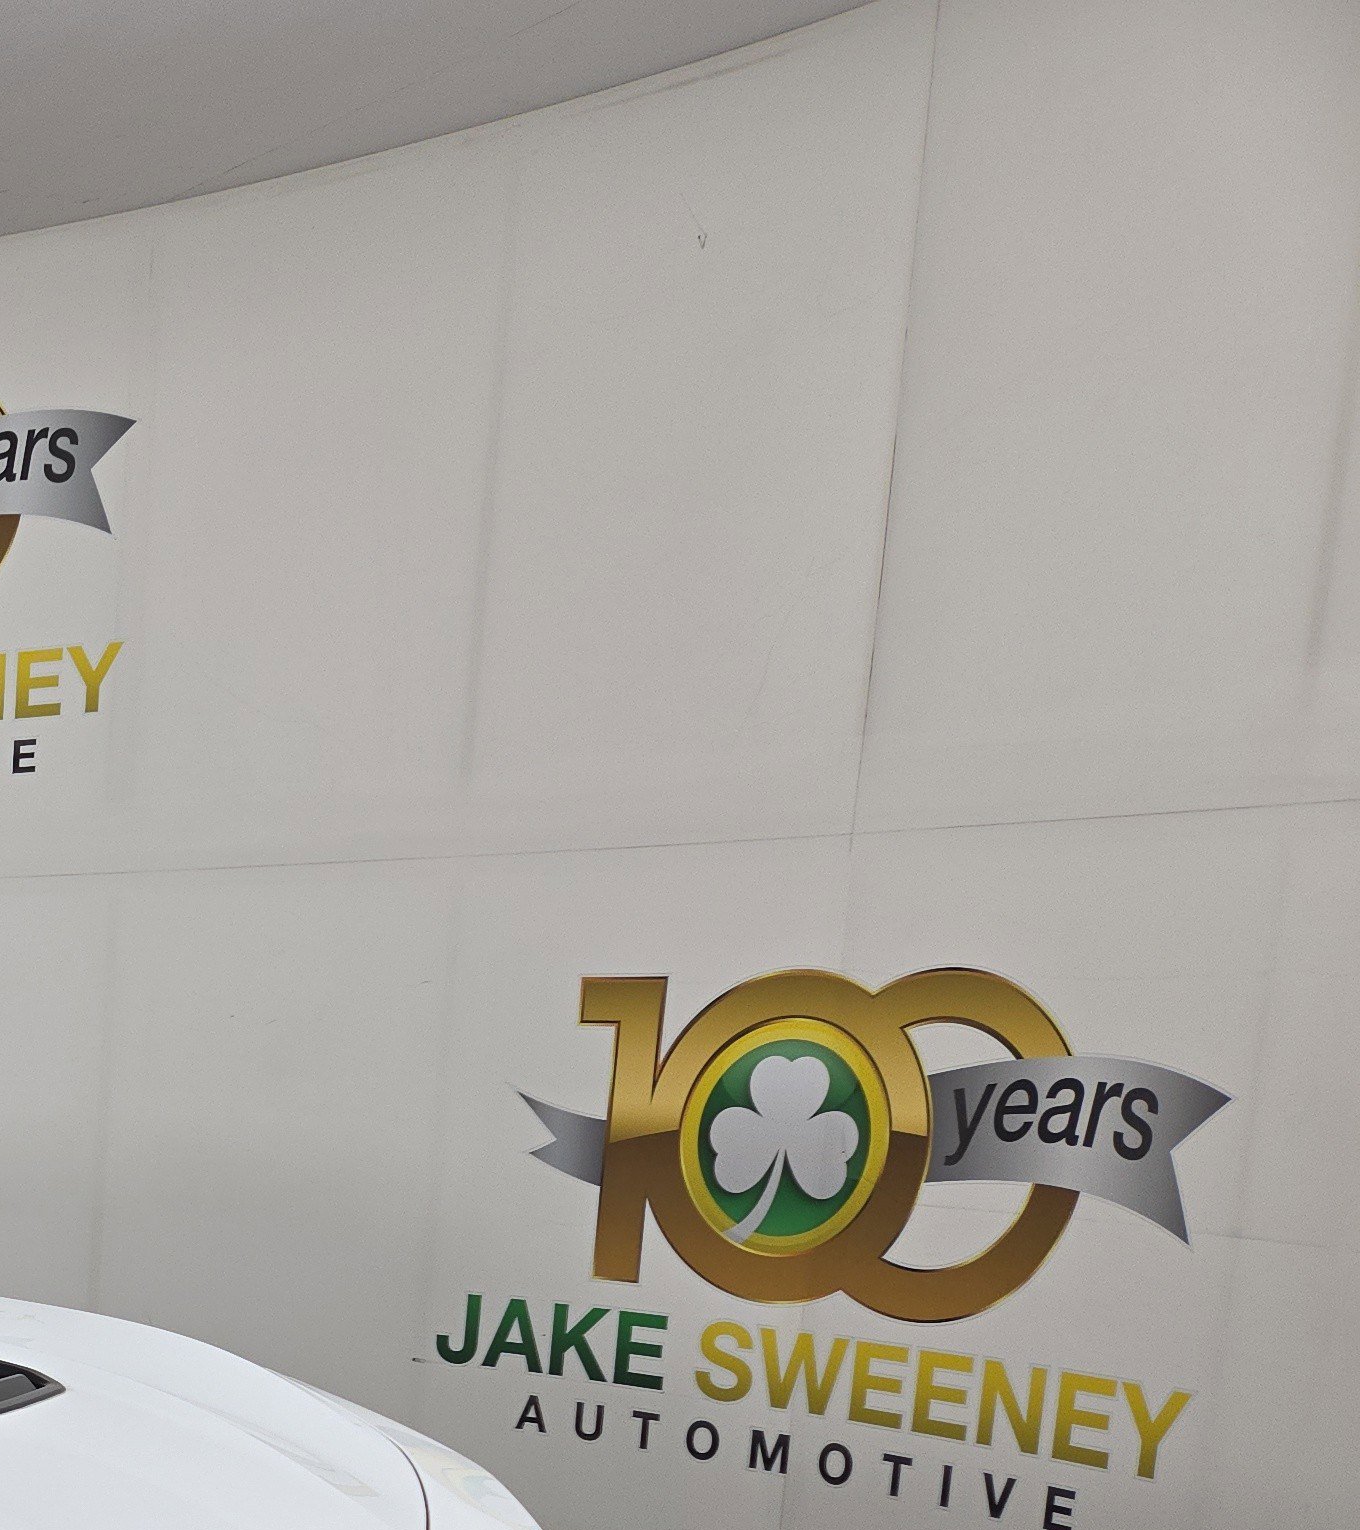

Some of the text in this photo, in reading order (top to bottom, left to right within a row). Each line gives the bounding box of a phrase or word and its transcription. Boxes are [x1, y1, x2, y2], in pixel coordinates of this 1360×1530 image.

[580, 966, 1081, 1324] 100
[943, 1077, 1160, 1168] years
[435, 1293, 1193, 1481] JAKE SWEENEY
